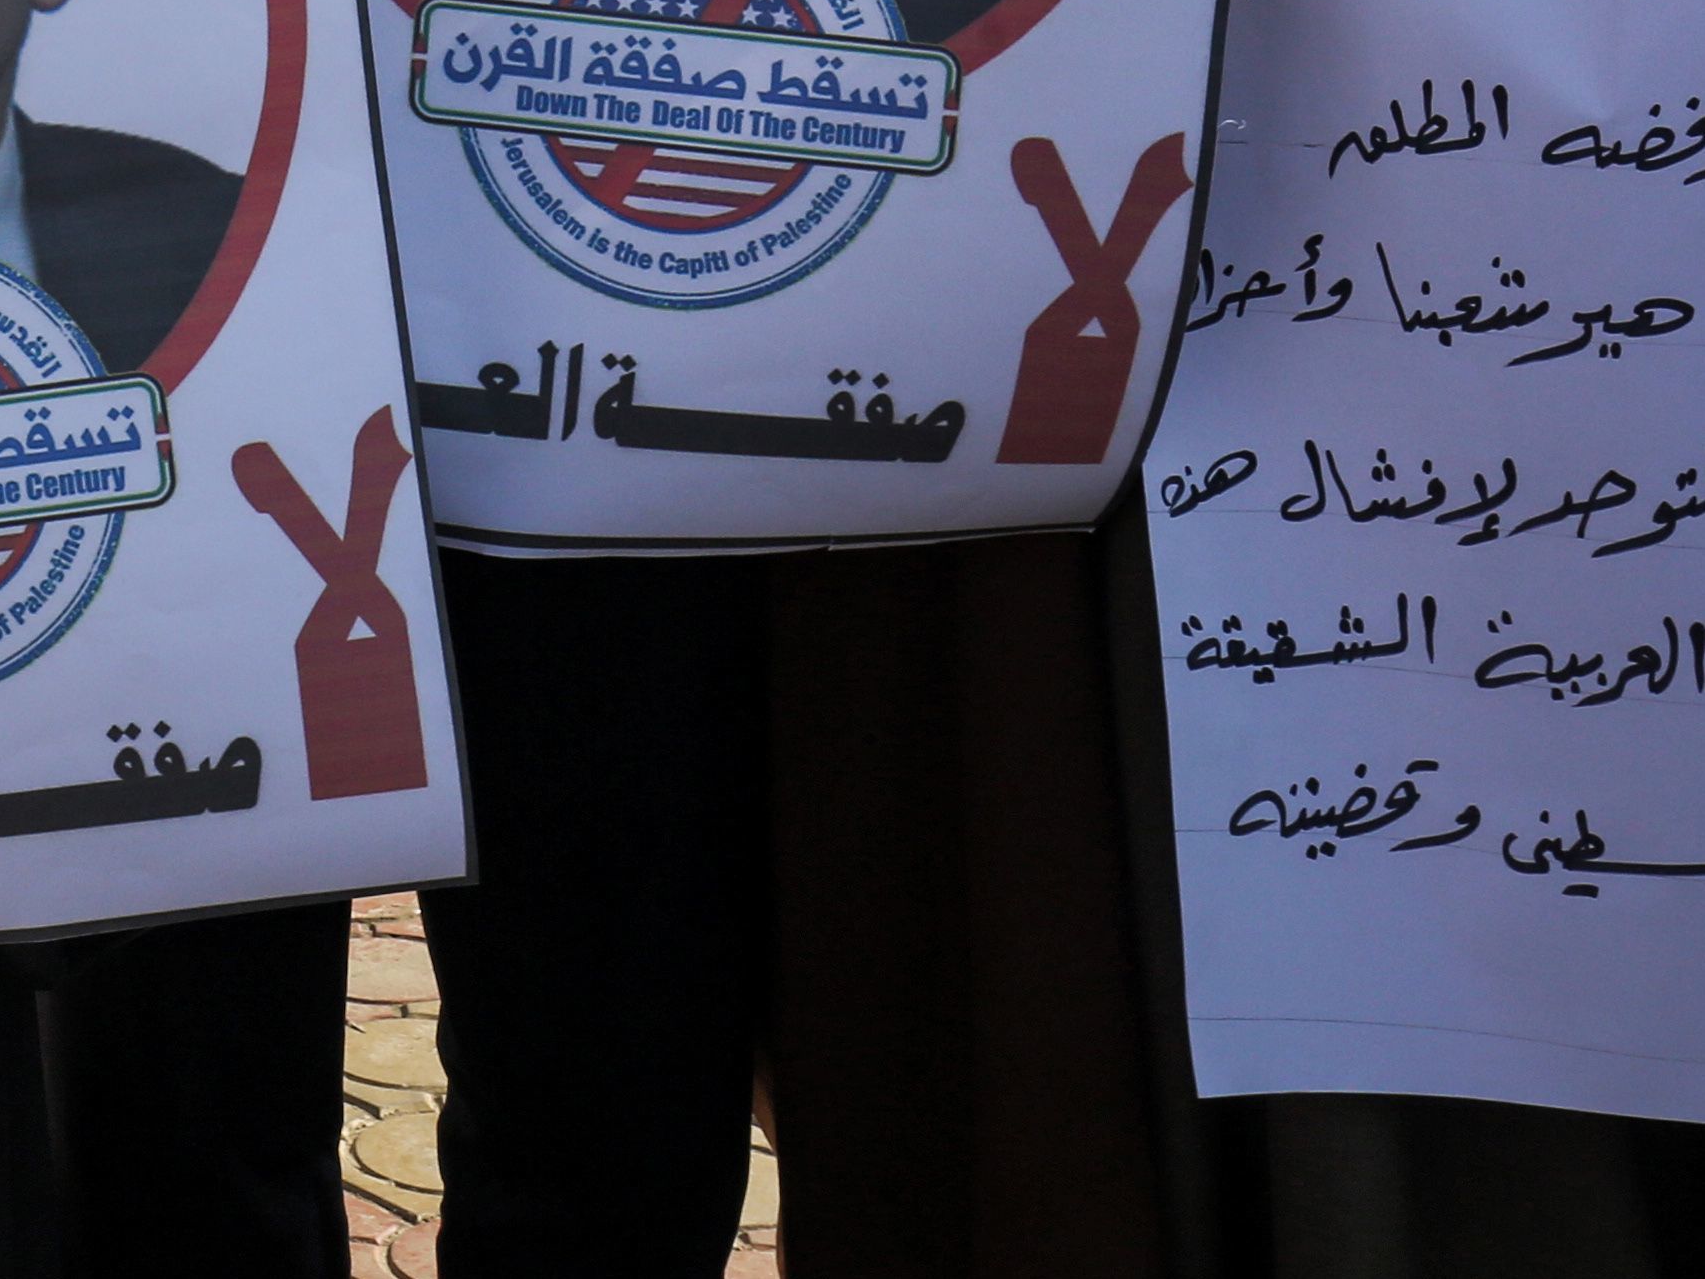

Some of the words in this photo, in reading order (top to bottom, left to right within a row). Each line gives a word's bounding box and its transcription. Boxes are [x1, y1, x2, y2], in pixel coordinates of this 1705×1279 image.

[442, 21, 574, 93] القرن
[582, 33, 748, 101] صفقة
[756, 54, 930, 120] تسقط
[515, 84, 588, 119] Down
[593, 92, 642, 125] The
[651, 98, 711, 133] Deal
[716, 104, 746, 136] Of
[748, 110, 797, 143] The
[801, 112, 906, 155] Century
[500, 135, 587, 243] Jerusalem
[587, 227, 611, 256] is
[612, 242, 654, 272] the
[658, 251, 730, 281] Capitl
[733, 240, 761, 270] of
[761, 172, 854, 259] Palestine
[1184, 233, 1354, 334] وأحزا
[1375, 241, 1550, 348] شعبنا
[415, 340, 585, 443] الع
[592, 351, 968, 465] صفقة
[25, 464, 127, 505] Century
[1160, 448, 1258, 519] هذه
[1279, 439, 1520, 547] لإفشال
[11, 522, 86, 628] Palestine
[1180, 591, 1439, 685] الشقيقة
[1474, 609, 1705, 708] العربية
